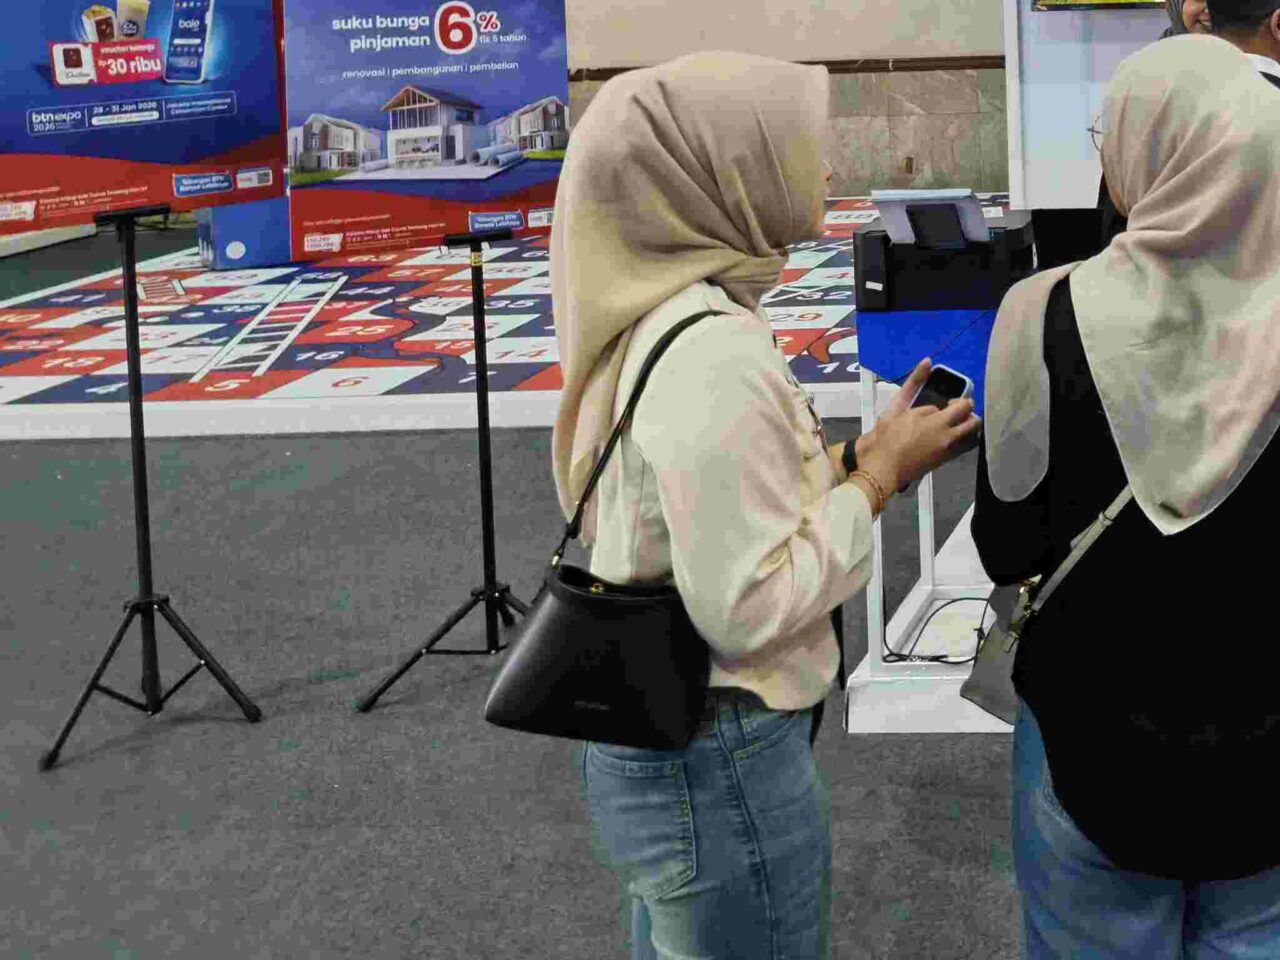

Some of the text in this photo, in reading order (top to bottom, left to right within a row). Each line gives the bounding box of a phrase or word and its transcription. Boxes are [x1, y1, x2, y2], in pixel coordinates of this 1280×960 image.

[332, 15, 430, 30] suku bunga
[350, 34, 431, 53] pinjaman
[500, 33, 527, 43] tahun
[130, 56, 162, 73] ribu
[342, 61, 519, 80] renovasi pembangunan pembelian
[121, 103, 137, 112] Jan
[796, 290, 853, 301] 32
[770, 312, 823, 322] 29
[324, 324, 395, 337] 25
[204, 379, 251, 392] 5
[331, 376, 370, 388] 6
